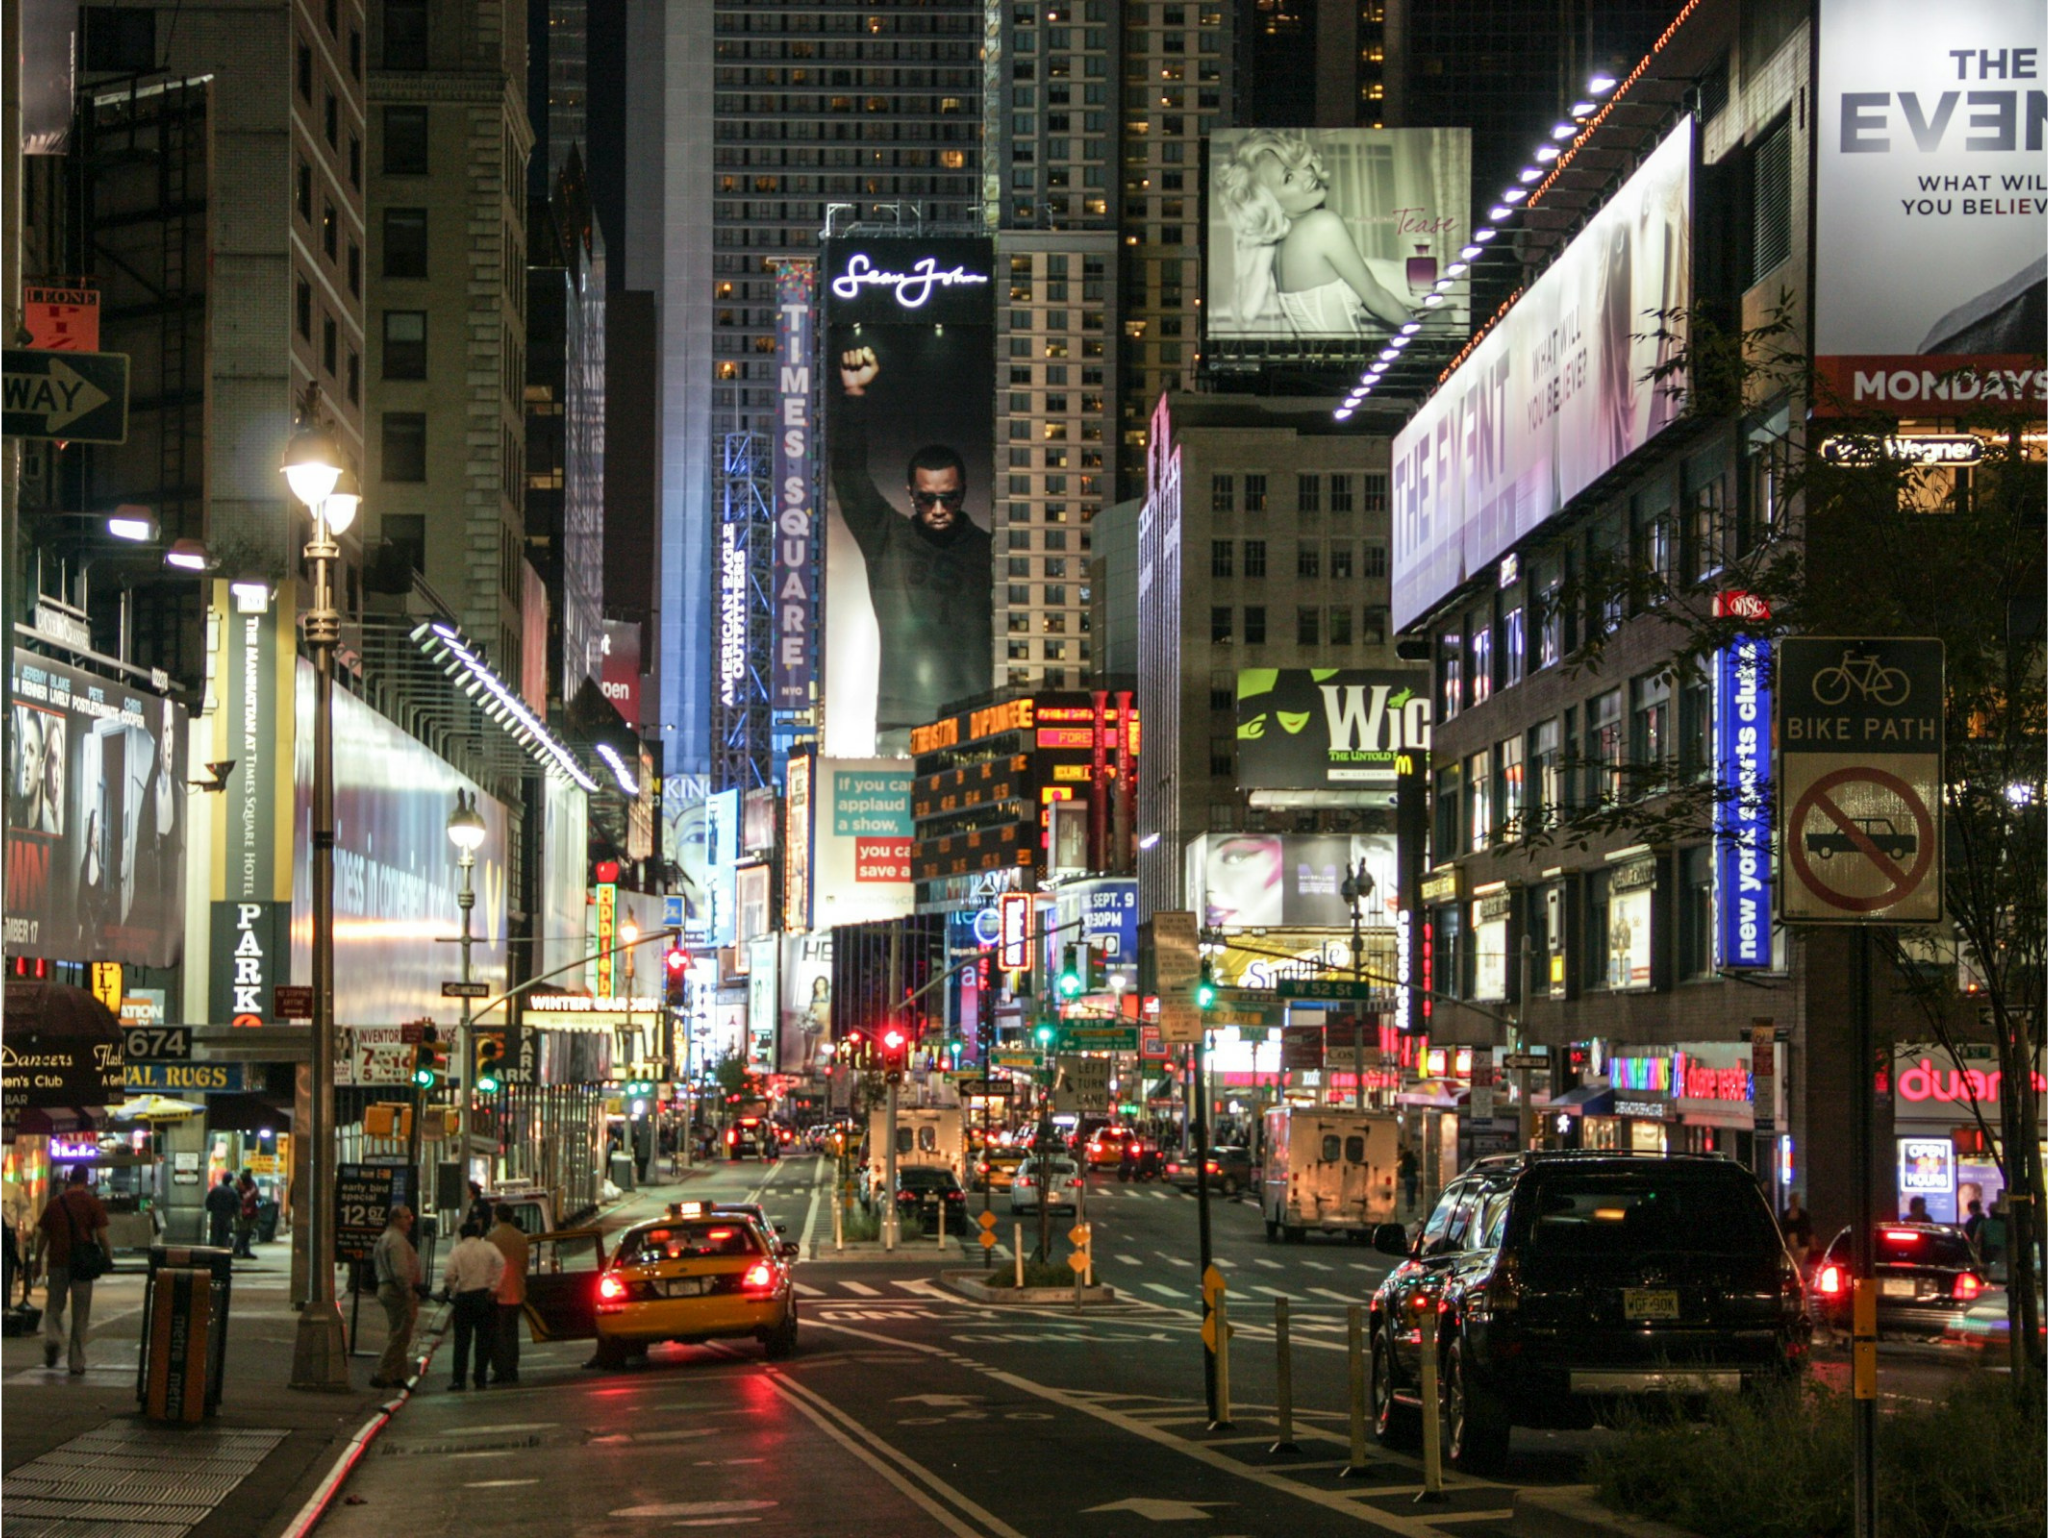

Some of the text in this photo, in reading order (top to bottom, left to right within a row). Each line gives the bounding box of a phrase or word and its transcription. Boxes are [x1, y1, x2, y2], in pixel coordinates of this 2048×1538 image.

[1949, 48, 2037, 80] THE
[1918, 175, 1991, 191] WHAT
[1902, 199, 1952, 215] YOU
[1393, 207, 1459, 236] Tease
[832, 253, 988, 307] Sean John
[27, 289, 98, 305] LEONE
[1532, 303, 1581, 384] WHAT WILL
[780, 304, 809, 458] TIMES
[3, 376, 83, 413] WAY
[1527, 346, 1587, 436] YOU BELIEVE?
[1395, 346, 1511, 564] THE EVENT
[780, 475, 809, 665] SQUARE
[721, 522, 735, 707] AMERICAN EAGLE
[732, 549, 746, 679] OUTFITTERS
[22, 665, 48, 684] JEREMY
[50, 674, 71, 692] BLAKE
[21, 679, 47, 701] RENNER
[50, 688, 70, 707] LIVELY
[782, 686, 804, 696] NYC
[124, 697, 142, 713] CHRIS
[121, 710, 144, 728] COOPER
[1788, 717, 1936, 741] BIKE PATH
[242, 616, 260, 896] THE MANHATTAN AT TIMES SQUARE HOTEL
[1119, 707, 1130, 792] HERSHEYS
[838, 777, 850, 791] If
[855, 780, 884, 793] you
[838, 797, 906, 814] applaud
[838, 817, 899, 833] a show,
[860, 846, 891, 860] you
[1735, 826, 1761, 892] york
[859, 865, 897, 878] save
[1124, 891, 1135, 908] 9
[1738, 897, 1757, 960] new
[233, 903, 263, 1013] PARK
[1249, 941, 1341, 989] Snapple
[1293, 982, 1353, 995] W 52 St
[530, 995, 591, 1011] WINTER
[127, 1030, 187, 1057] 674
[358, 1028, 405, 1044] INVENTOR
[2, 1044, 74, 1068] Dancers
[361, 1047, 376, 1067] 7
[519, 1027, 534, 1083] PARK
[166, 1066, 228, 1088] RUGS
[1077, 1063, 1105, 1075] LEFT
[34, 1074, 64, 1089] Club
[1077, 1080, 1106, 1090] TURN
[4, 1093, 29, 1106] BAR
[1076, 1095, 1105, 1106] LANE
[60, 1132, 98, 1142] ATM
[1908, 1145, 1946, 1158] OPEN
[342, 1183, 389, 1193] early bird
[1907, 1174, 1947, 1186] HOURS
[341, 1192, 377, 1203] special
[341, 1204, 385, 1226] 12 67
[172, 1315, 186, 1362] metro
